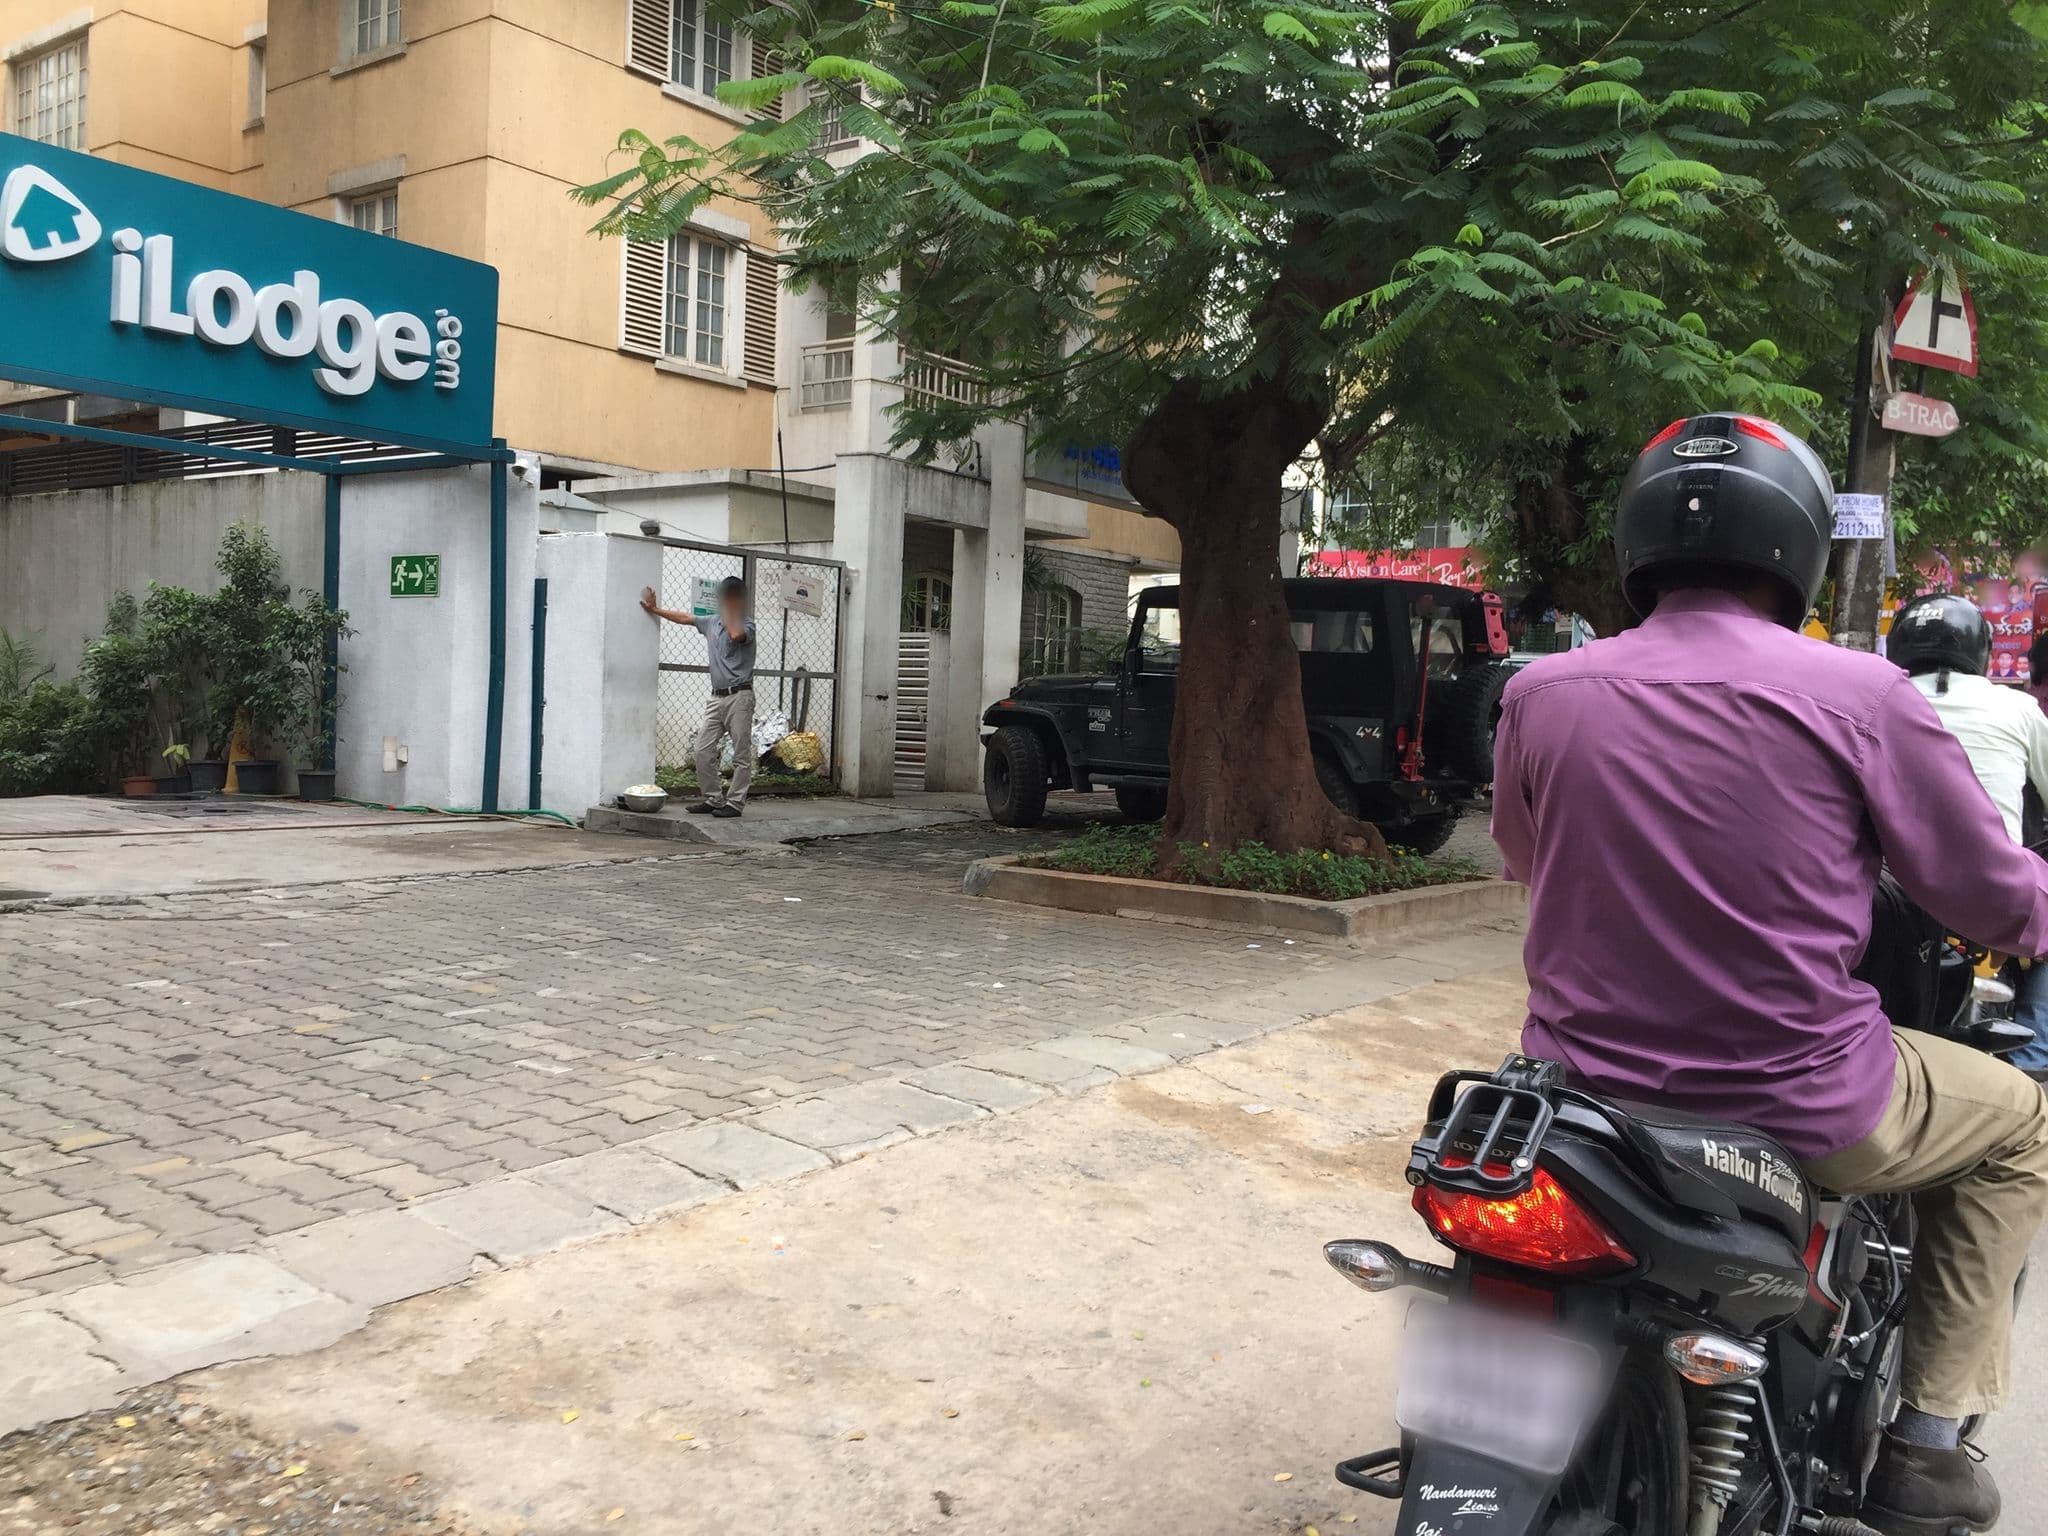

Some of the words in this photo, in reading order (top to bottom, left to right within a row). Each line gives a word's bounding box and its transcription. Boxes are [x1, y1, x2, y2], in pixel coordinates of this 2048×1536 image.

[110, 227, 432, 396] iLodge
[435, 308, 462, 390] .com
[1887, 399, 1955, 431] B-TRAC
[1391, 560, 1421, 576] Care
[1701, 1138, 1755, 1185] Haiku
[1420, 1484, 1497, 1501] Nandamuri
